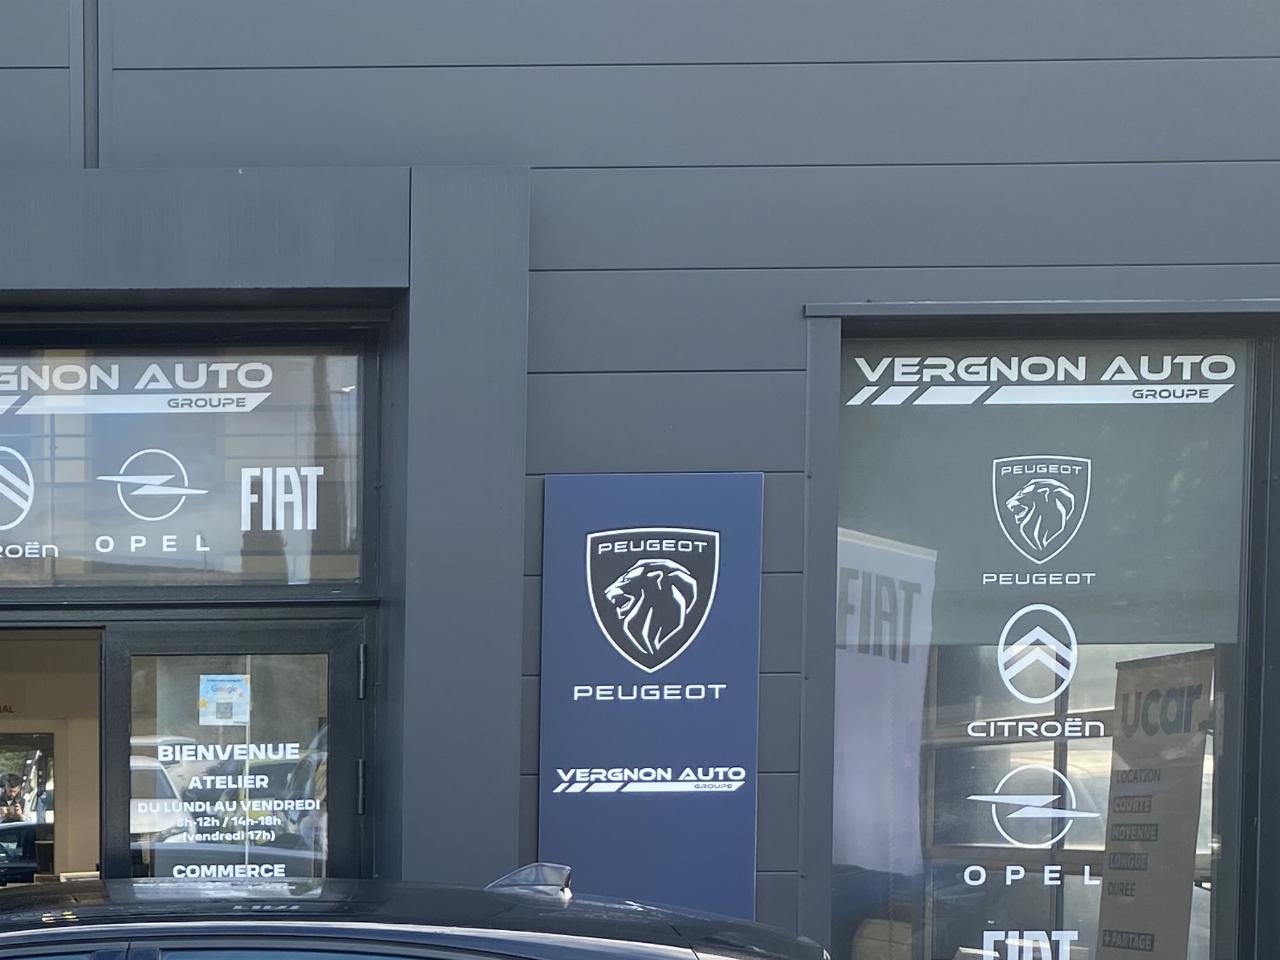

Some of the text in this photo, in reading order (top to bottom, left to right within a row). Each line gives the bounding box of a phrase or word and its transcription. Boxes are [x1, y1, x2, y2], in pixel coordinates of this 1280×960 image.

[134, 361, 274, 390] AUTO
[854, 354, 1237, 382] VERGNON AUTO
[1132, 388, 1209, 399] GROUPE
[167, 397, 247, 409] GROUPE
[1001, 464, 1083, 476] PEUGEOT
[240, 466, 324, 531] FIAT
[95, 535, 210, 553] OPEL
[598, 539, 708, 555] PEUGEOT
[982, 572, 1097, 585] PEUGEOT
[835, 566, 922, 664] FIAT
[573, 684, 727, 701] PEUGEOT
[158, 743, 300, 761] BIENVENUE
[188, 775, 269, 789] ATELIER
[556, 767, 746, 781] VERGNON AUTO
[138, 799, 321, 813] DU LUNDI AU VENDREDI
[173, 864, 286, 878] COMMERCE
[963, 864, 1101, 886] OPEL
